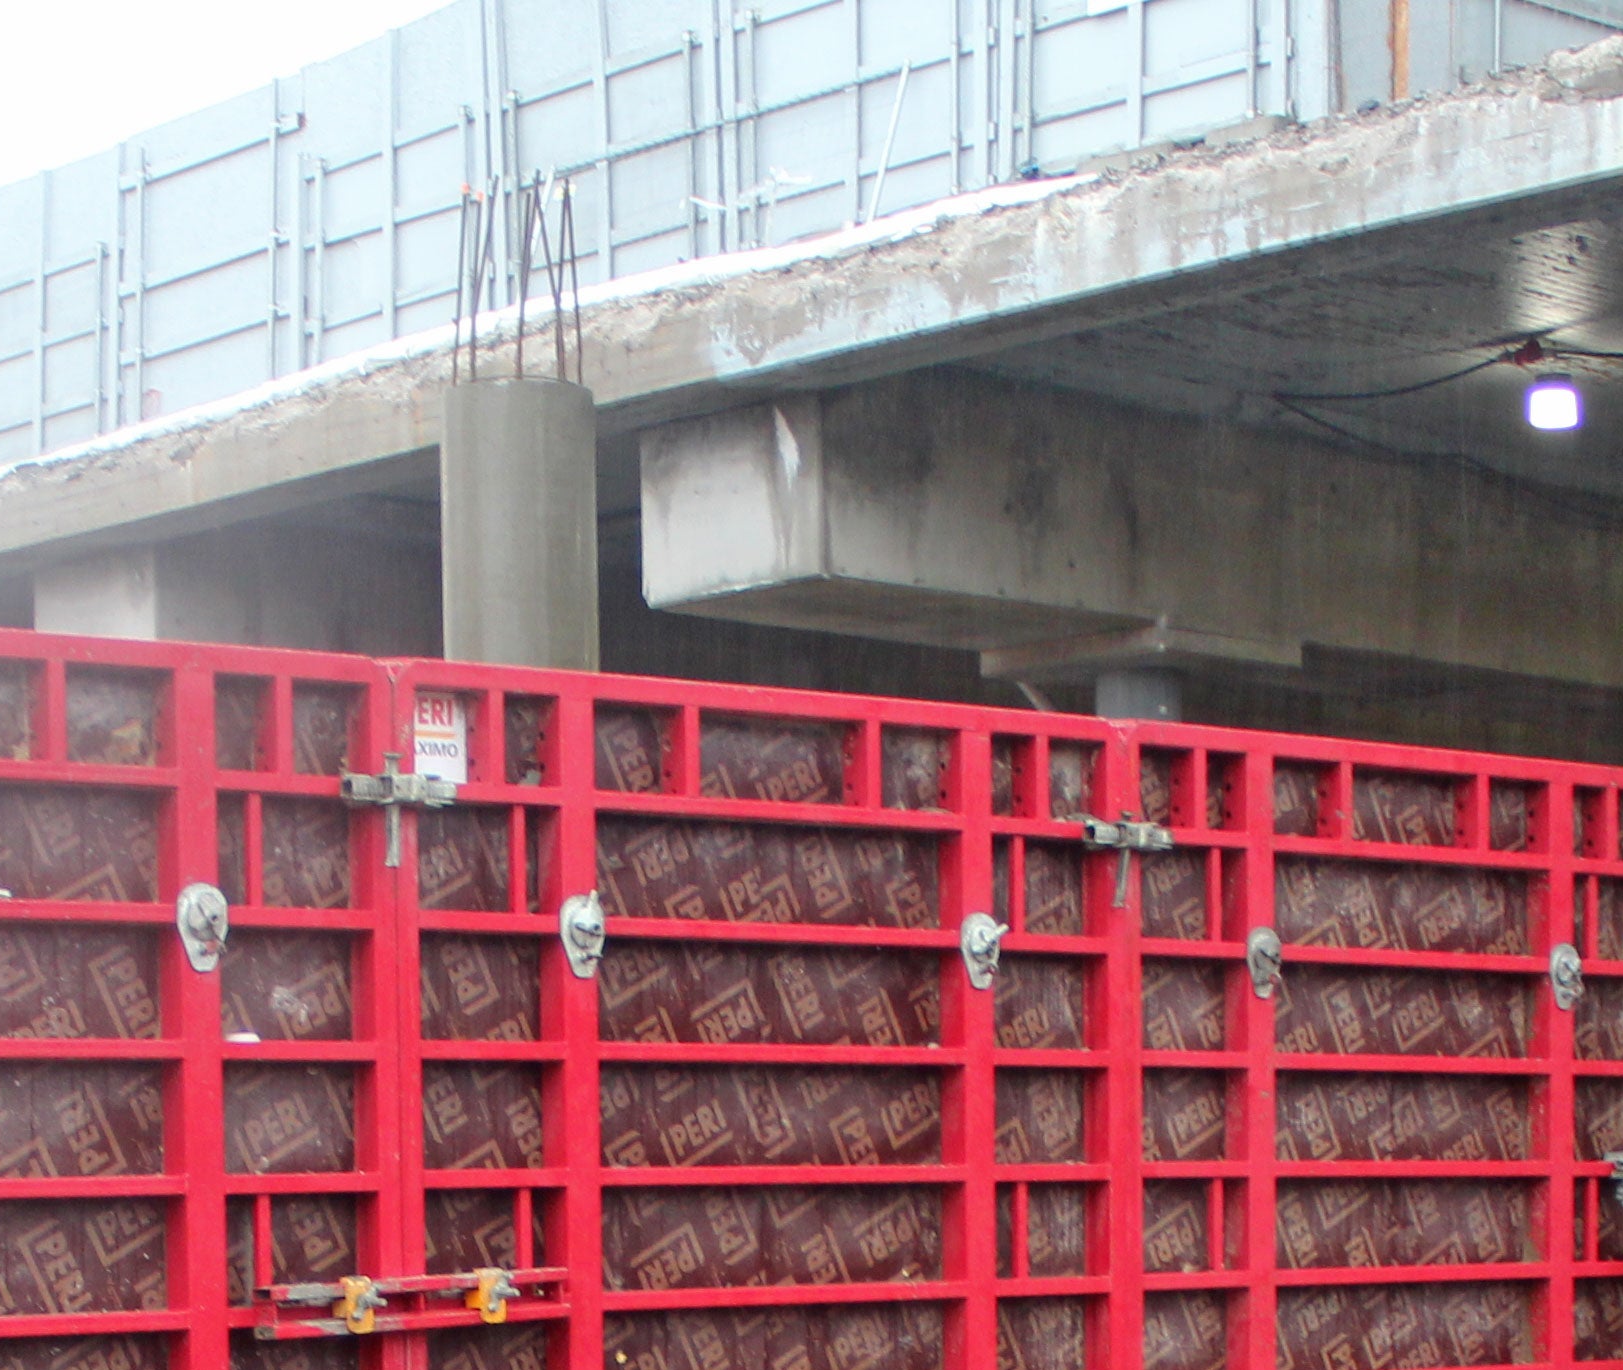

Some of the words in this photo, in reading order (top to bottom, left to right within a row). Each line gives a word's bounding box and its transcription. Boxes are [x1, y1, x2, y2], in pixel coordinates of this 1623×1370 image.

[419, 701, 454, 725] ERI
[614, 719, 652, 792] PER
[768, 757, 825, 801] PERI
[422, 841, 464, 886] ERI
[698, 1000, 762, 1043] PERI
[856, 1002, 893, 1047] ERI
[999, 1005, 1051, 1048] PERI
[1398, 993, 1439, 1037] PERI
[243, 1094, 310, 1145] PERI
[428, 1078, 466, 1133] ERI
[670, 1099, 726, 1155] PERI
[1176, 1096, 1220, 1140] PERI
[800, 1232, 837, 1284] ERI
[862, 1214, 915, 1268] PERI
[1148, 1219, 1200, 1268] PERI
[637, 1244, 700, 1291] PERI
[835, 1316, 893, 1370] PERI
